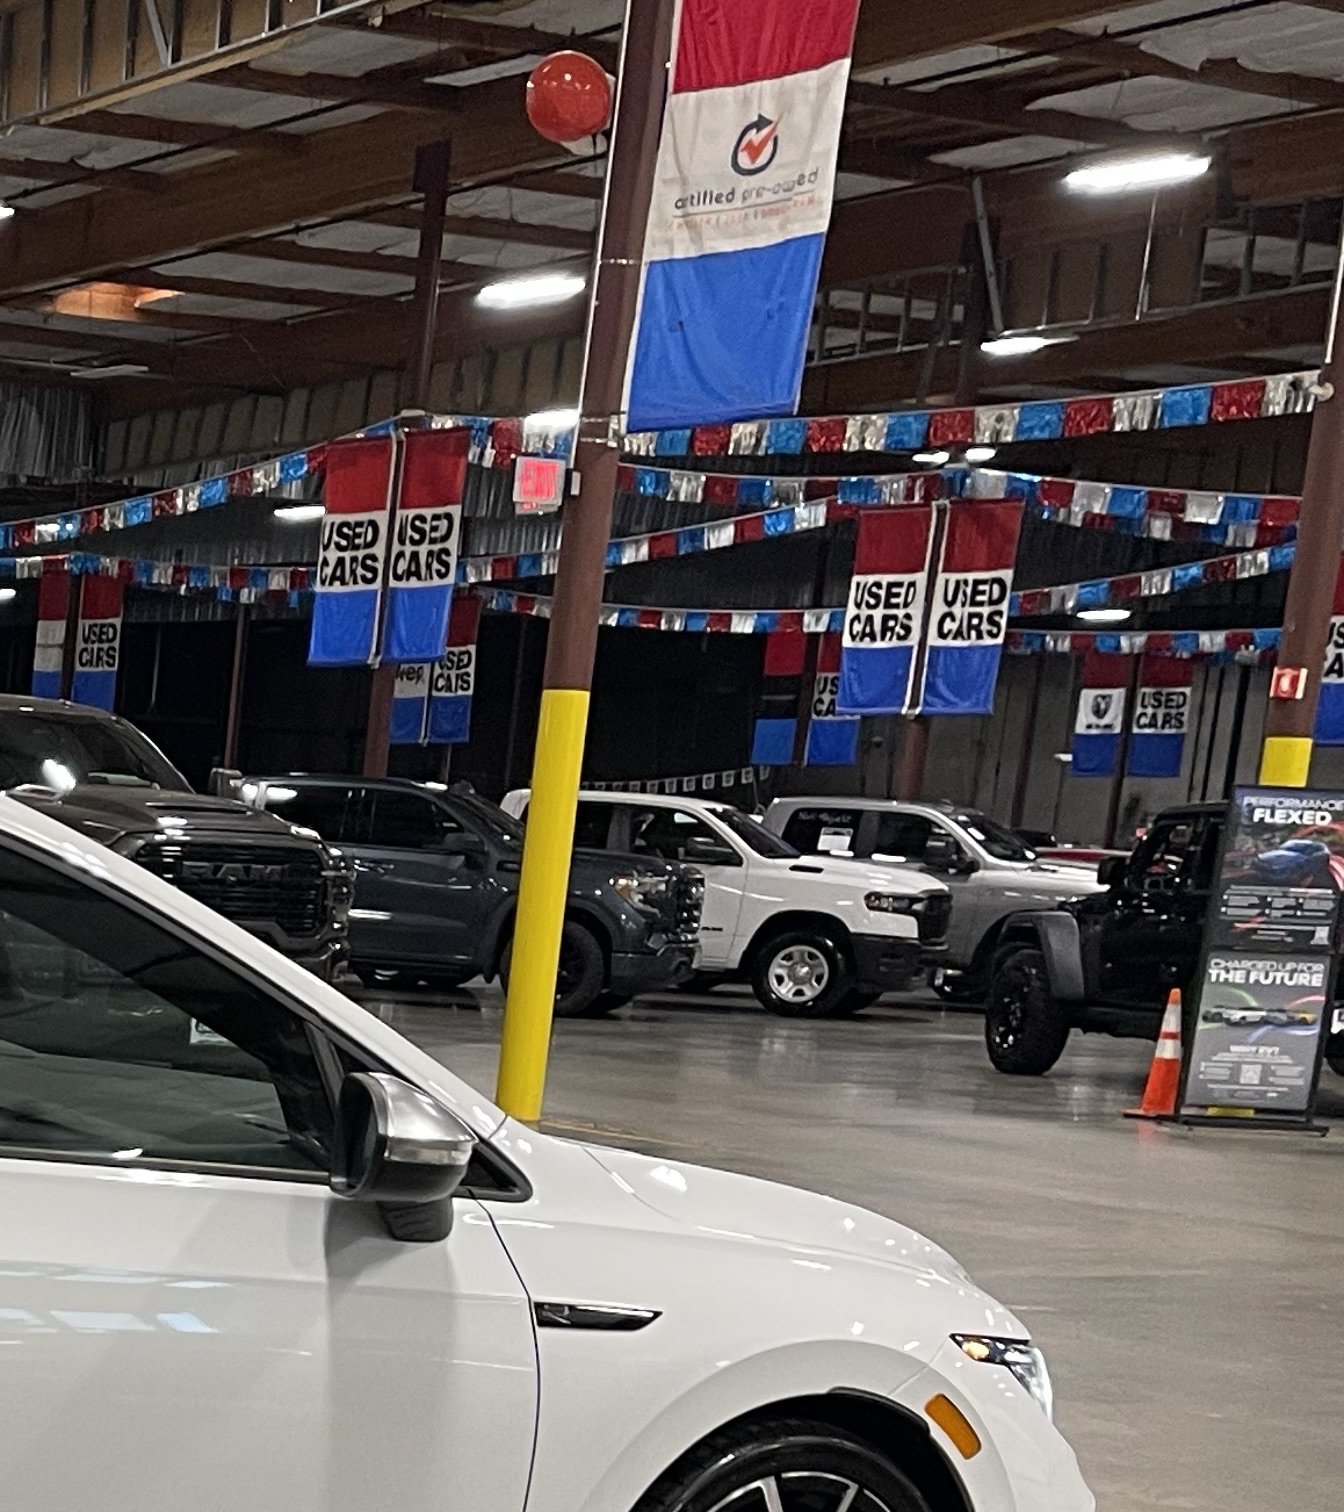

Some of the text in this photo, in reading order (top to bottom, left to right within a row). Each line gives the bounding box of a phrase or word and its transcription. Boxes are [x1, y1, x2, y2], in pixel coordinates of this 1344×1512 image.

[321, 519, 380, 552] USED
[397, 512, 454, 546] USED
[319, 553, 379, 587] CARS
[392, 547, 452, 582] CARS
[854, 580, 917, 611] USED
[944, 576, 1008, 608] USED
[82, 622, 118, 645] USED
[848, 612, 913, 643] CARS
[937, 610, 1005, 641] CARS
[1135, 711, 1185, 730] CARS
[1252, 808, 1333, 827] FLEXED
[1208, 969, 1325, 987] THE FUTURE
